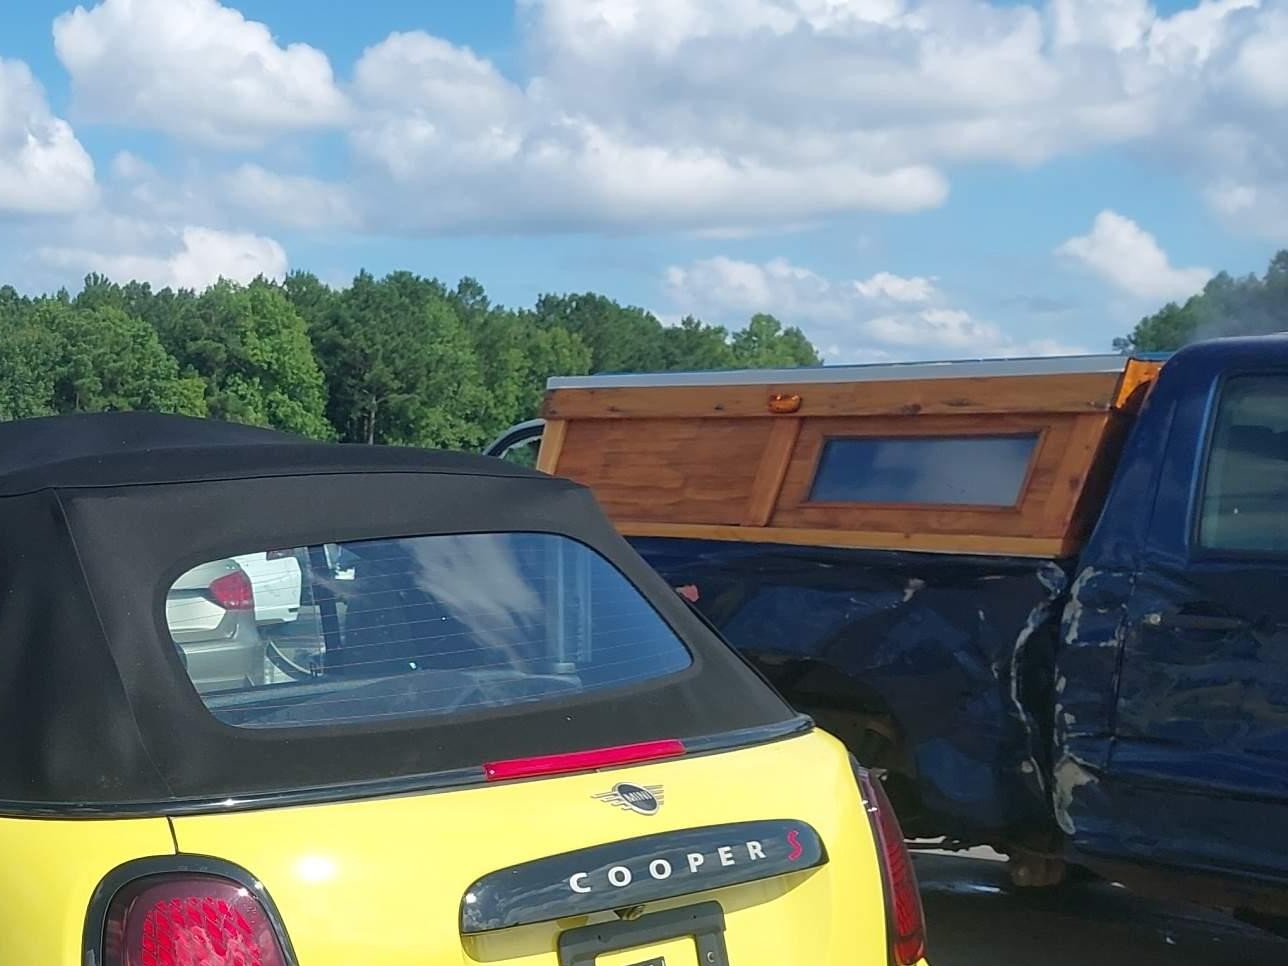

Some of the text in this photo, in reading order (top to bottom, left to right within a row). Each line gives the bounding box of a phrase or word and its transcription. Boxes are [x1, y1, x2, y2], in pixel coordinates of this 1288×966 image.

[622, 790, 653, 803] MINI
[569, 830, 803, 893] COOPER S
